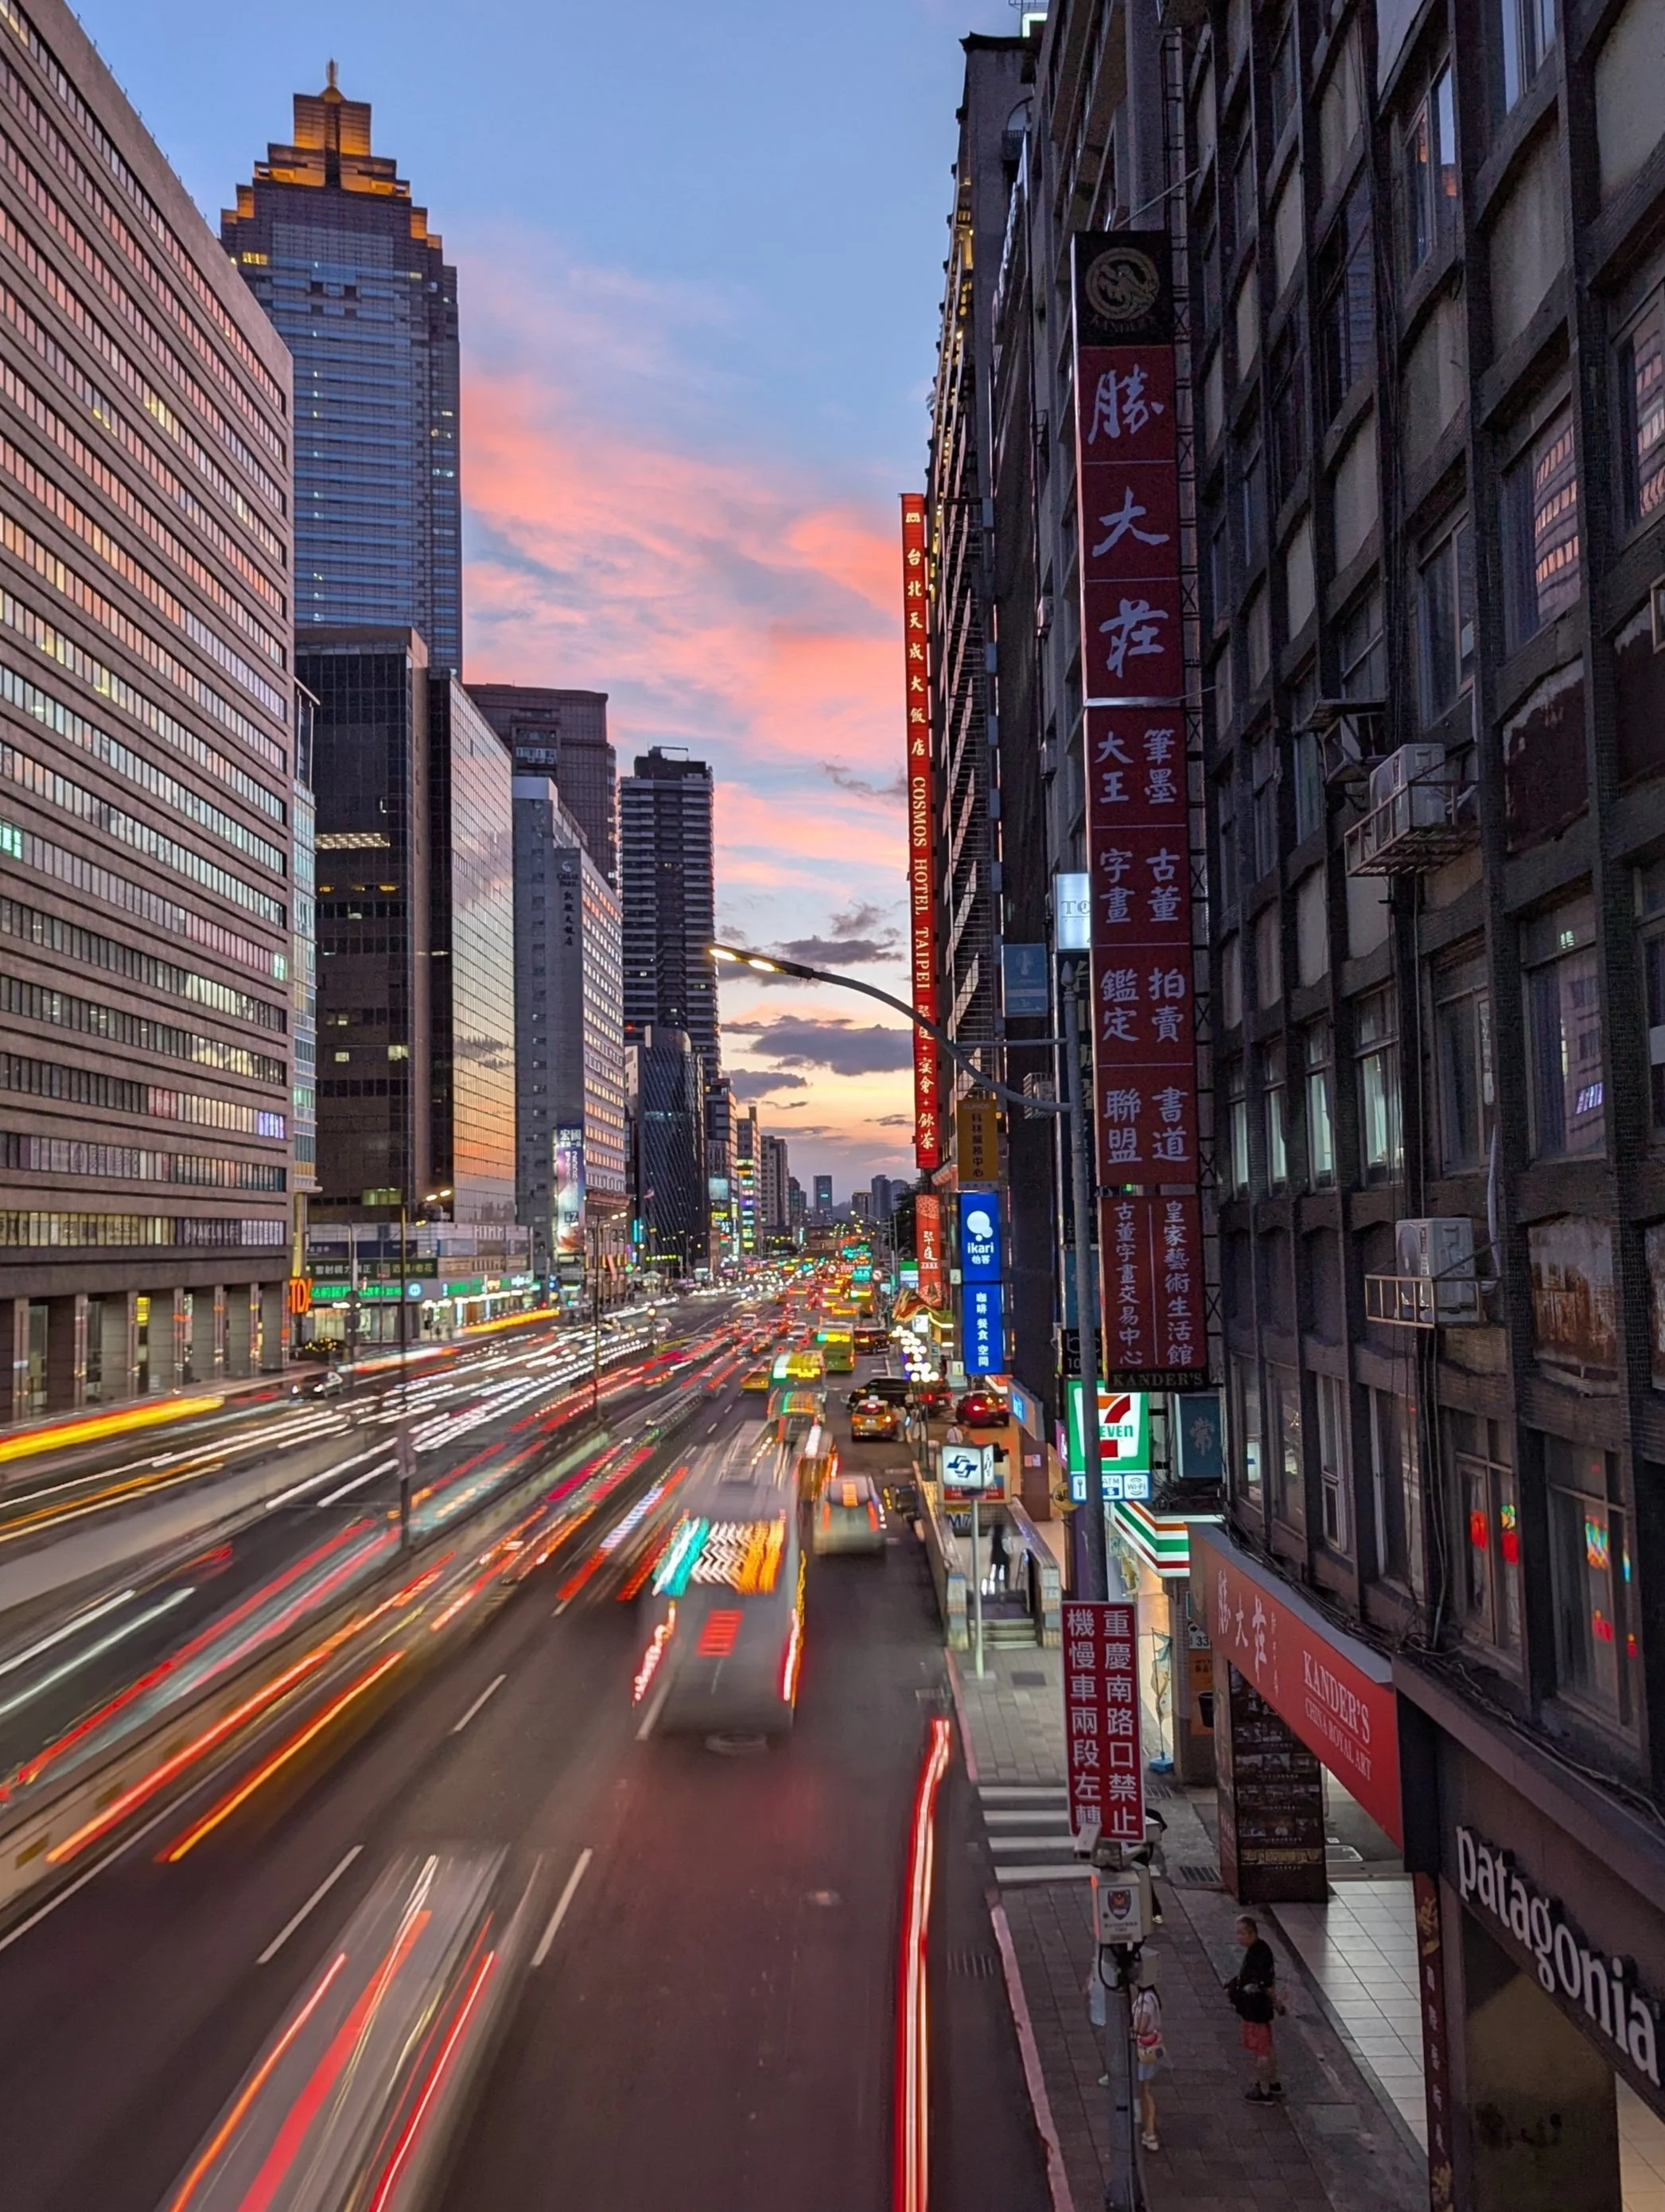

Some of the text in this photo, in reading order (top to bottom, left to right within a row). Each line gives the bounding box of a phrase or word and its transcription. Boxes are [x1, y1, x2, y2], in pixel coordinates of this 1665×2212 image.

[907, 549, 926, 757] 台北天成大飯店
[1095, 731, 1134, 804] 大王
[1143, 728, 1177, 804] 筆墨
[912, 776, 930, 989] COSMOS HOTEL TAIPEI
[1099, 848, 1136, 924] 字畫
[1146, 847, 1182, 923] 古董
[1100, 968, 1140, 1042] 鑑定
[1148, 968, 1185, 1043] 拍賣
[918, 1057, 935, 1094] 宴會
[1103, 1088, 1142, 1164] 聯盟
[1151, 1086, 1191, 1162] 書道
[967, 1242, 994, 1254] ikari
[1115, 1202, 1143, 1366] 古董字畫交易中心
[1164, 1200, 1194, 1366] 皇家藝術生活館
[975, 1292, 990, 1367] 咖啡 餐食 空間
[1113, 1373, 1203, 1387] KANDER'S
[1196, 1636, 1210, 1646] 33
[1067, 1608, 1101, 1827] 機慢車兩段左轉
[1103, 1610, 1138, 1836] 重慶南路口禁止
[1303, 1650, 1371, 1744] KANDER'S
[1305, 1696, 1371, 1782] CHINA ROYAL ART
[1455, 1825, 1661, 2088] patagonia
